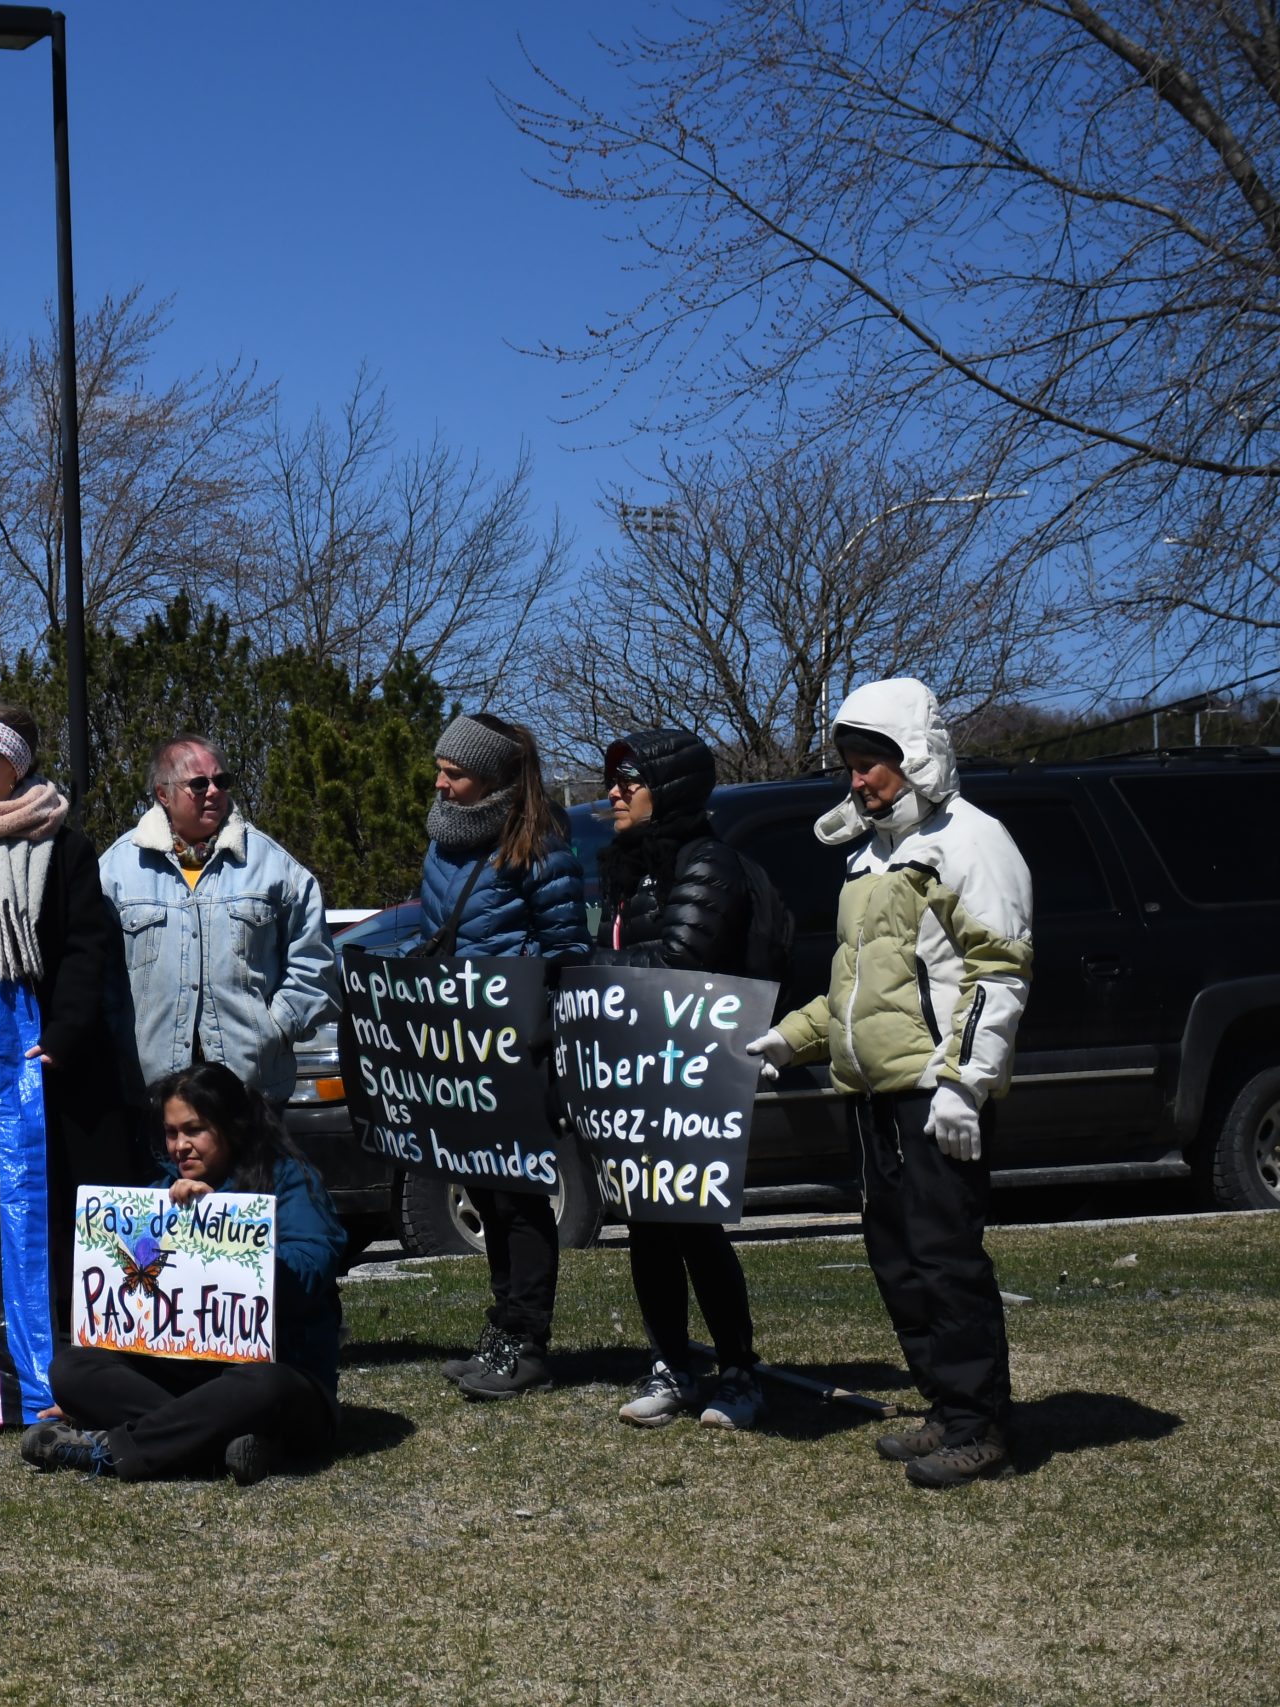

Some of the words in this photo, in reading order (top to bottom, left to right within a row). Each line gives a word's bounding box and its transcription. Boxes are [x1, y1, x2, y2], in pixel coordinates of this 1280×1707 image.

[341, 956, 366, 994] la
[369, 960, 510, 1020] planète
[663, 982, 742, 1030] vie
[351, 1013, 401, 1053] ma
[406, 1018, 521, 1064] vulve
[555, 1035, 568, 1077] et
[575, 1039, 719, 1092] liberté
[382, 1094, 412, 1124] les
[430, 1127, 557, 1185] humides
[85, 1196, 134, 1239] Pas
[150, 1199, 178, 1238] de
[189, 1198, 269, 1247] Nature
[148, 1287, 185, 1342] DE
